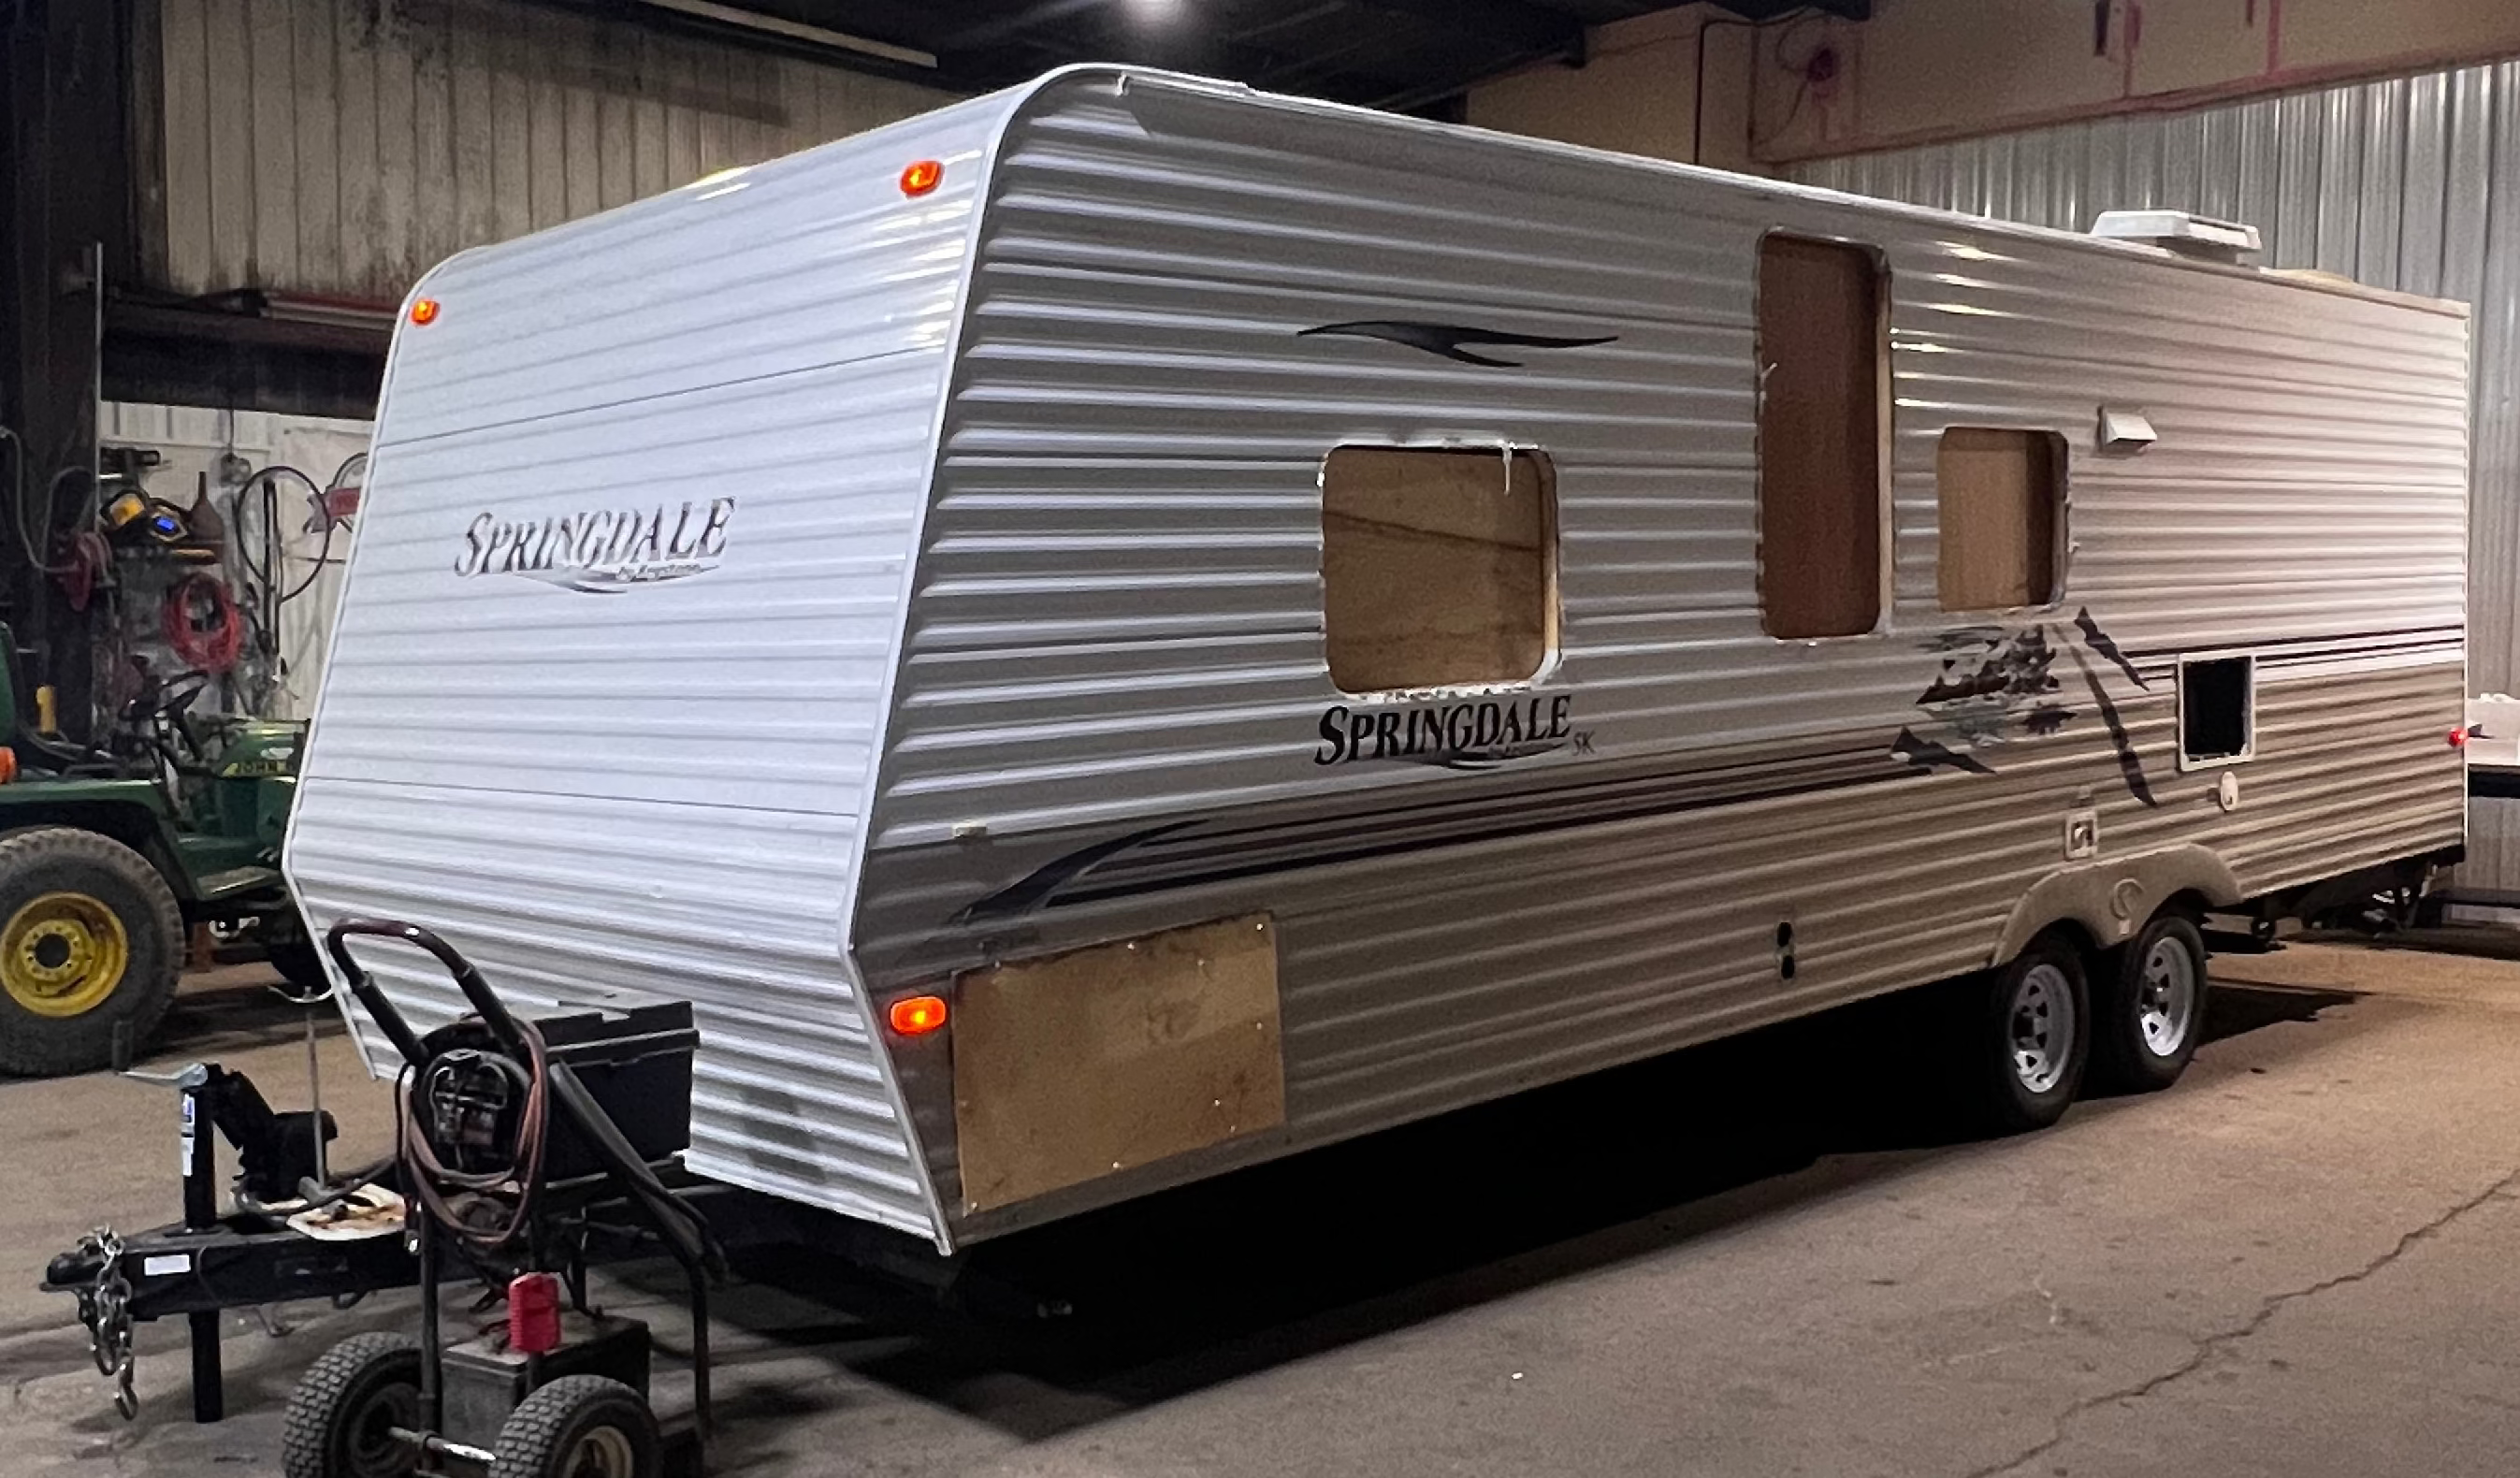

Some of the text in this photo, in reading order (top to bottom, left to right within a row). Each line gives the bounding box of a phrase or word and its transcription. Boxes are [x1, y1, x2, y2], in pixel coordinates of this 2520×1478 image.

[455, 496, 735, 576] SPRINGDALE
[1314, 696, 1596, 765] SPRINGDALE SK
